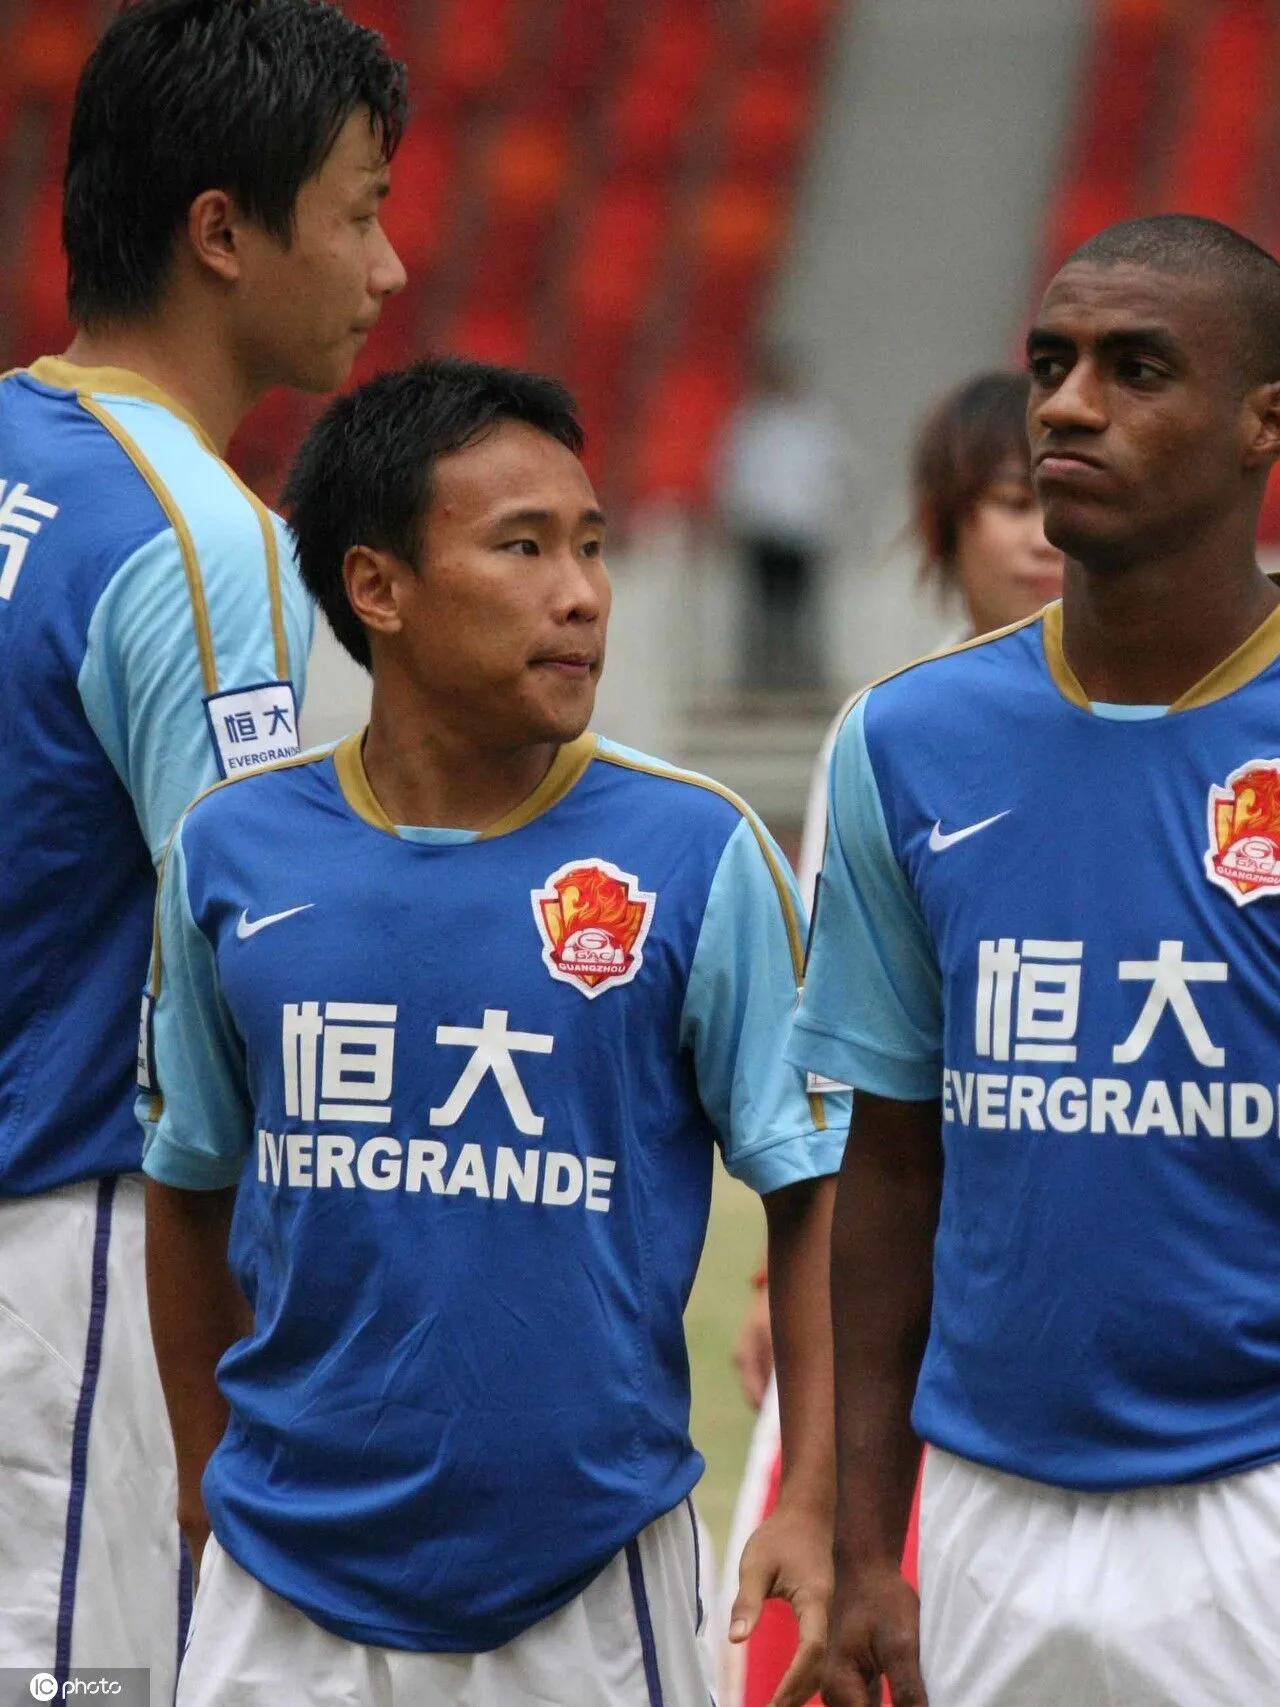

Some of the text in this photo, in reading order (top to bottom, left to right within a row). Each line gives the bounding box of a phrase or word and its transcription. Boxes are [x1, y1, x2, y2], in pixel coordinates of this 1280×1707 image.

[223, 705, 293, 743] 恒大
[559, 962, 627, 974] GUANGZHOU
[574, 950, 612, 961] GAC
[976, 938, 1228, 1068] 恒大
[282, 1001, 554, 1136] 恒大
